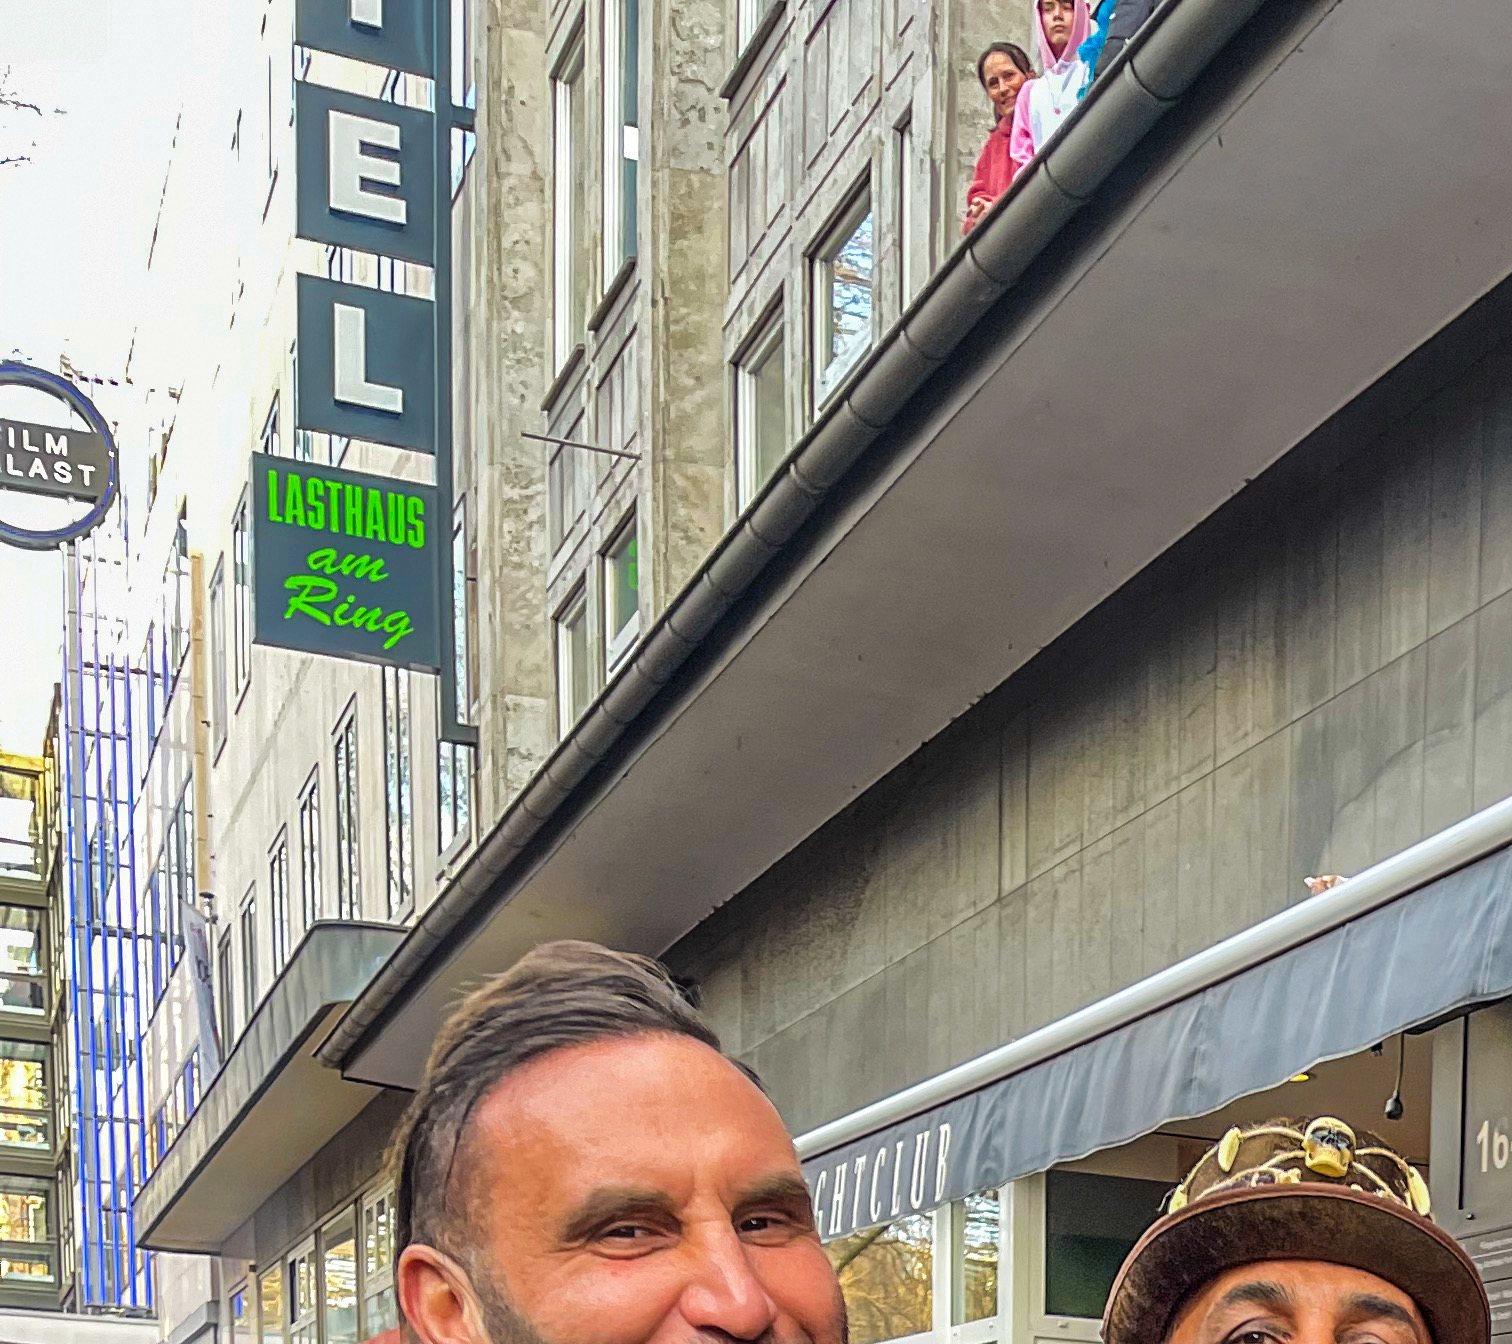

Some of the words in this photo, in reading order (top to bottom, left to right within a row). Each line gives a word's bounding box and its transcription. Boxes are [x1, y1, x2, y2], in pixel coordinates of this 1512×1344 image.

[328, 0, 407, 414] EL
[0, 425, 68, 457] ILM
[0, 453, 96, 487] LAST
[267, 468, 425, 549] LASTHAUS
[307, 548, 389, 583] am
[283, 575, 414, 650] Ring
[814, 1122, 951, 1240] GHTCLUB
